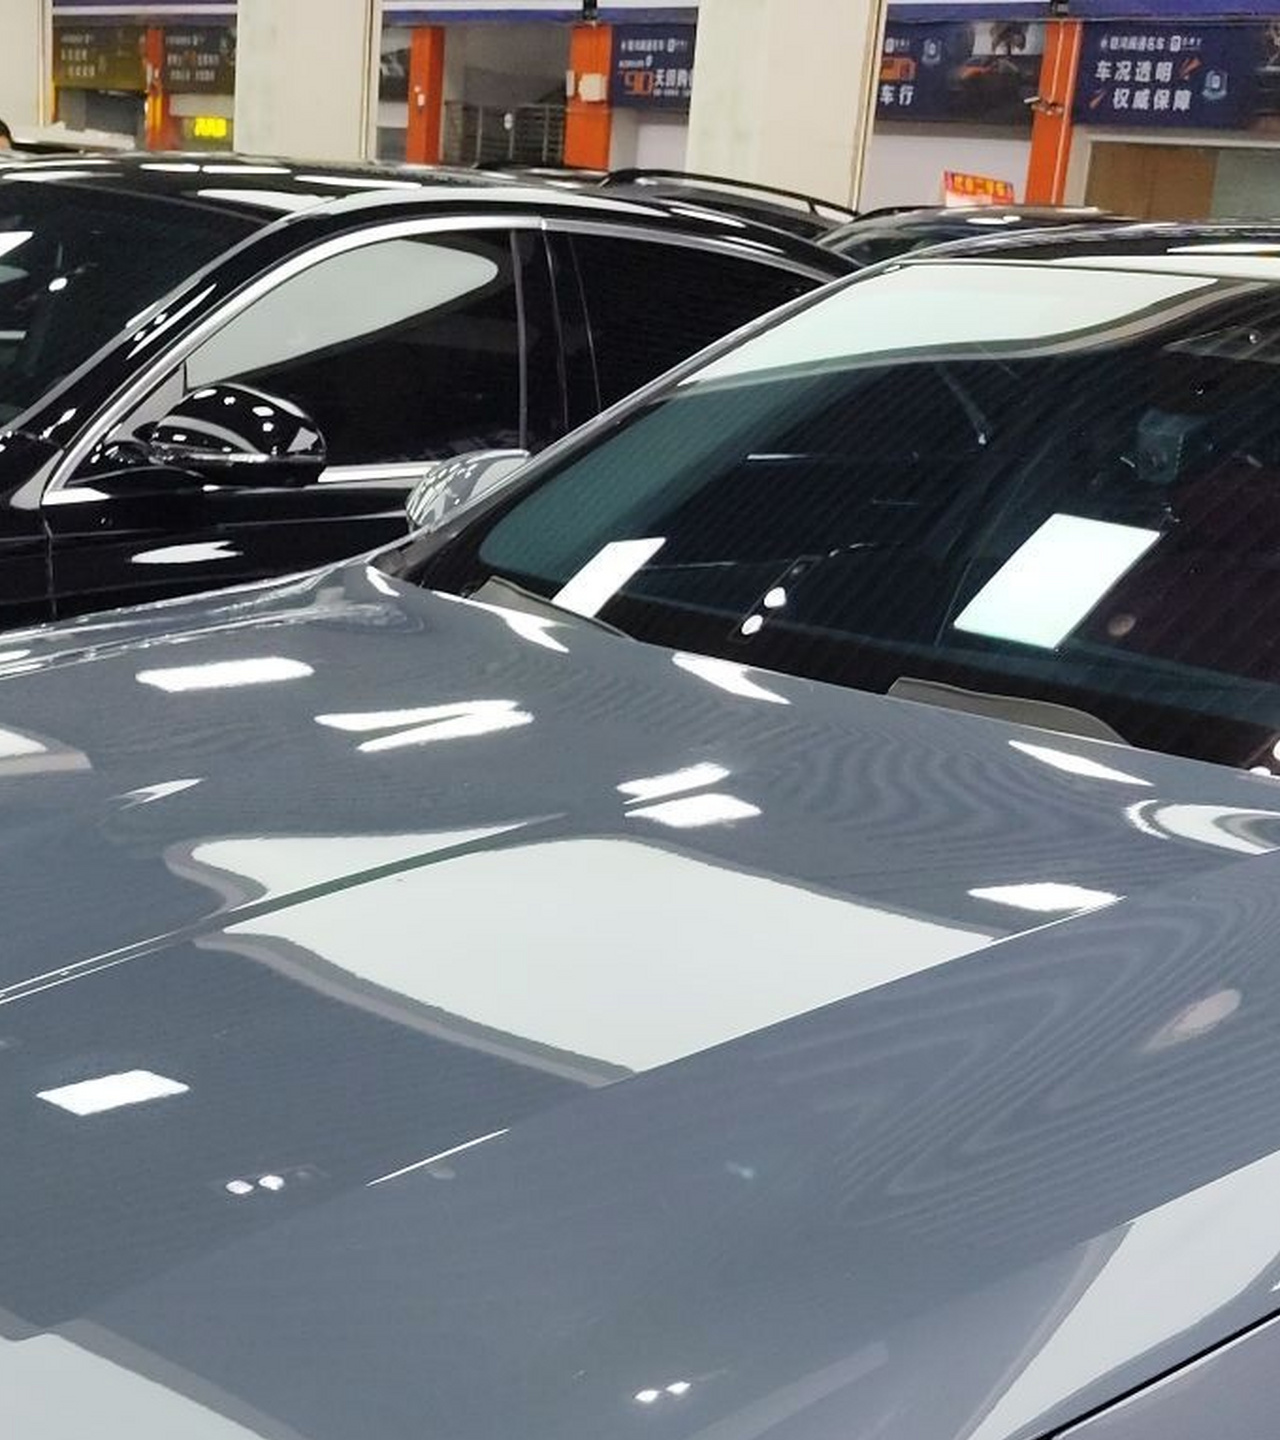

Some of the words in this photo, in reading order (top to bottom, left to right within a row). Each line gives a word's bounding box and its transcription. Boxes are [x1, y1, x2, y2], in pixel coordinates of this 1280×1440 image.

[1095, 60, 1172, 82] 车况透明
[1113, 88, 1192, 111] 权威保障
